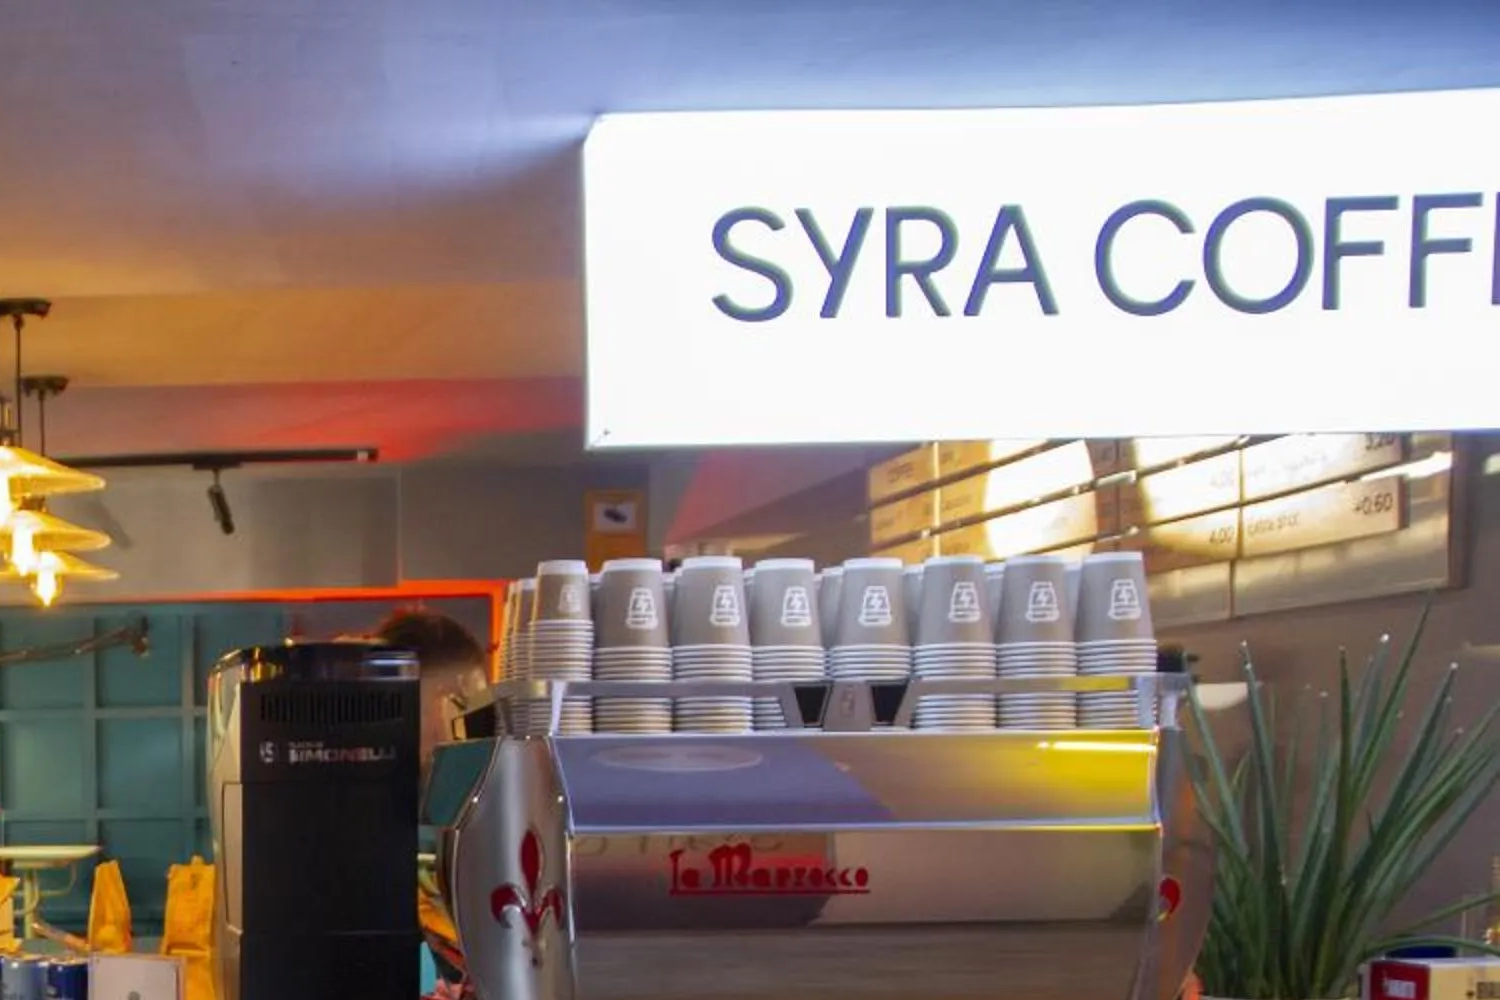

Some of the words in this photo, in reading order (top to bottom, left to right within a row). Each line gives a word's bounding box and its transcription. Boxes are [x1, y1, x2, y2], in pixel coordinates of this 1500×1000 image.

[711, 204, 1059, 323] SYRA
[1094, 192, 1500, 317] COFF
[709, 842, 869, 888] Marzocco
